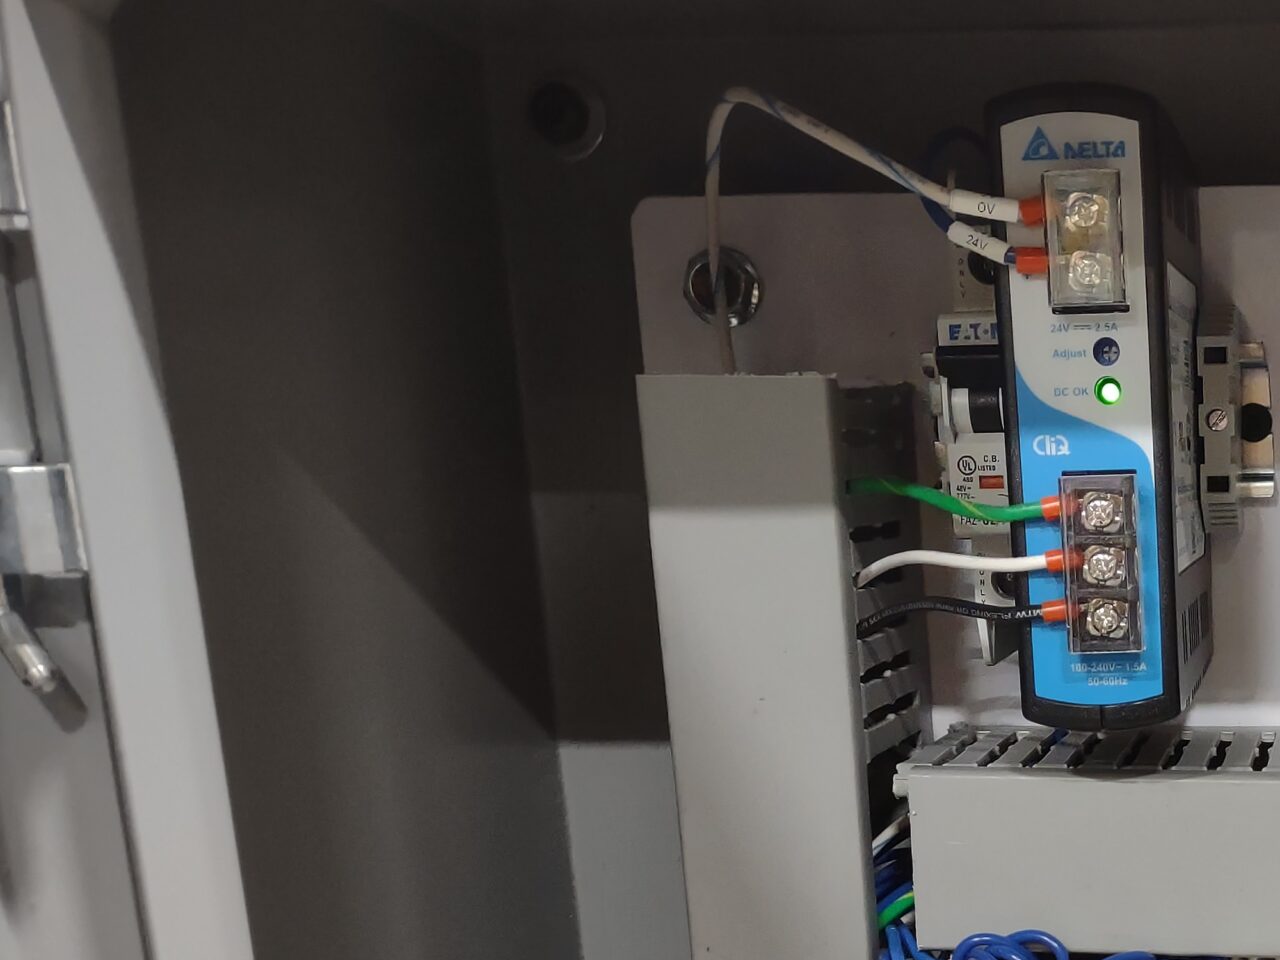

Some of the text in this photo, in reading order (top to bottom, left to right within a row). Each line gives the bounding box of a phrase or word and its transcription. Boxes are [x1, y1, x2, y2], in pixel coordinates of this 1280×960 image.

[977, 201, 996, 215] 0V
[965, 234, 989, 250] 24V
[1052, 348, 1088, 361] Adjust
[1053, 386, 1089, 397] DC OK
